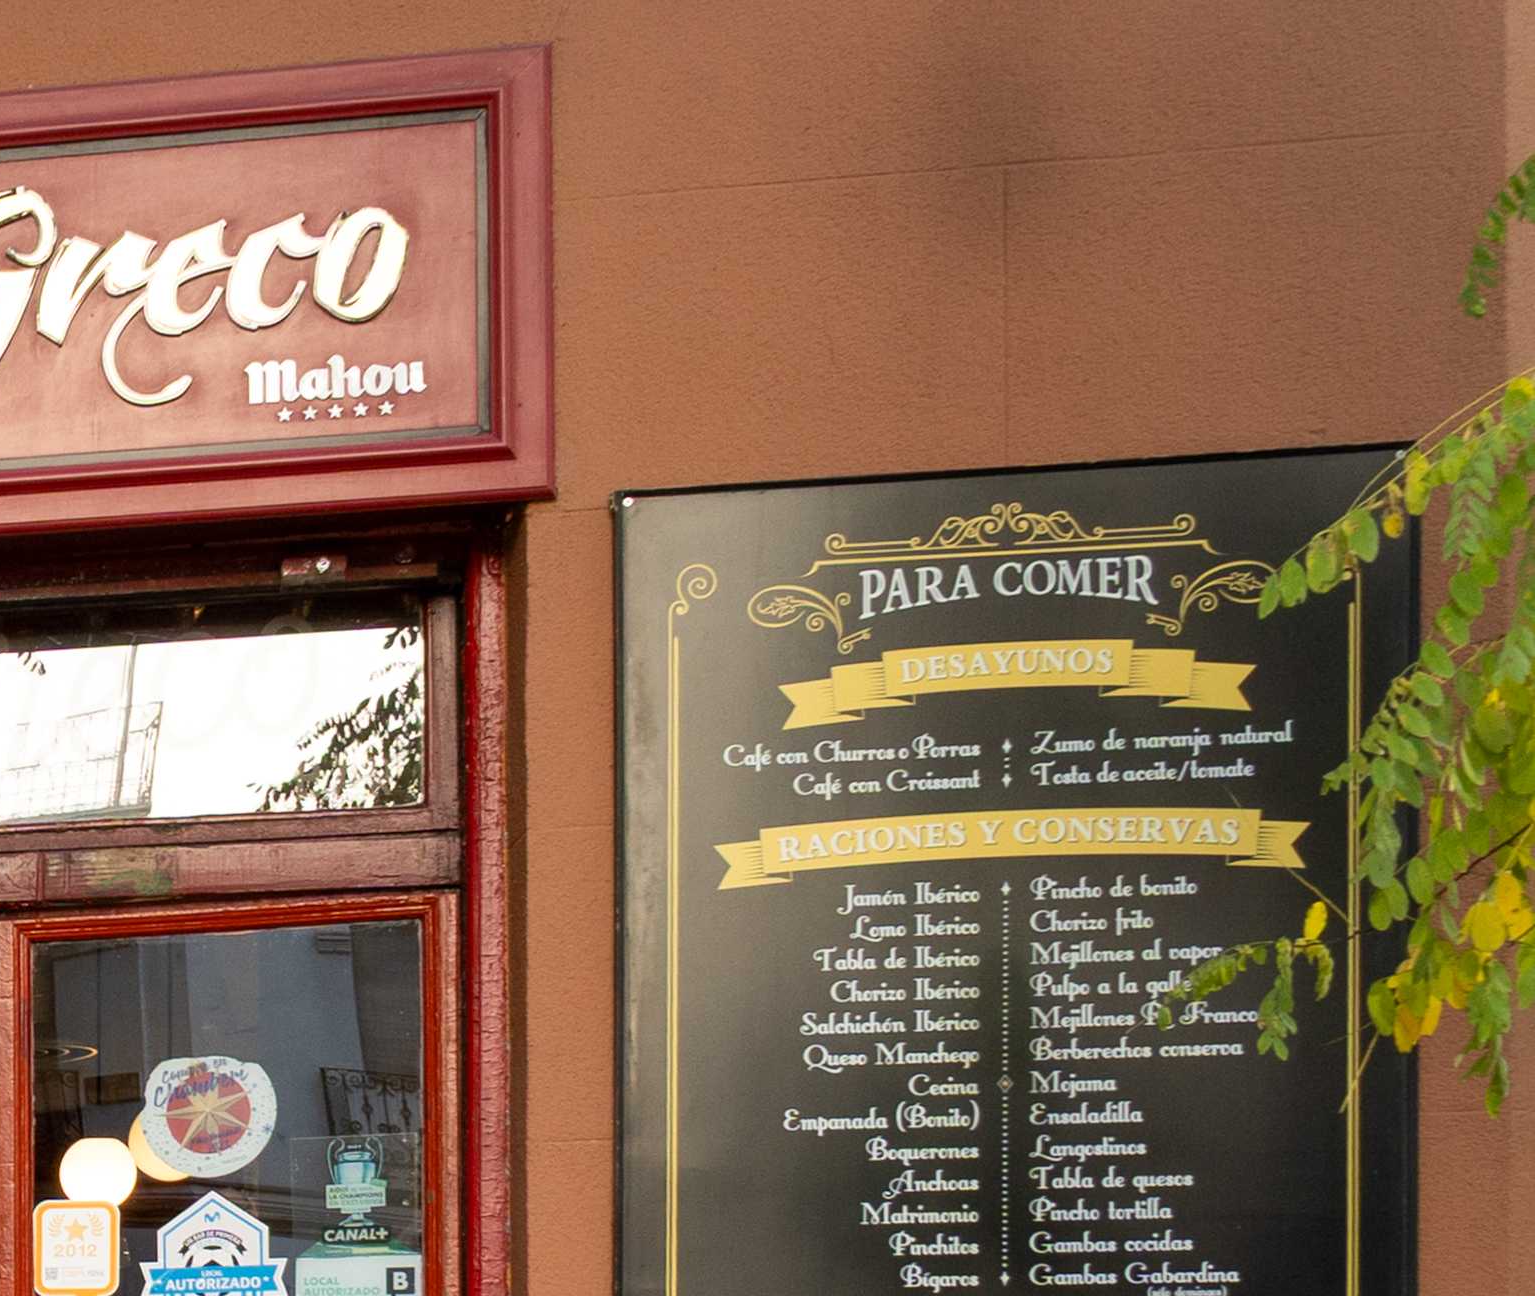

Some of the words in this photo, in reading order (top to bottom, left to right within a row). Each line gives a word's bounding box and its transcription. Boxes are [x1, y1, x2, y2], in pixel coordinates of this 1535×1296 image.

[247, 354, 427, 406] Mahou
[859, 565, 980, 620] PARA
[993, 555, 1158, 605] COMER
[902, 648, 1111, 681] DESAYUNOS
[1031, 731, 1095, 754] Zumo
[1103, 728, 1125, 750] de
[1134, 728, 1211, 756] naranja
[1220, 720, 1292, 744] natural
[722, 743, 772, 772] Café
[776, 748, 810, 766] con
[813, 740, 896, 763] Churros
[897, 746, 911, 760] o
[912, 733, 981, 759] Porras
[779, 823, 965, 863] RACIONES
[979, 820, 1001, 845] Y
[1014, 816, 1237, 842] CONSERVAS
[1030, 875, 1102, 900] Pincho
[1110, 875, 1133, 897] de
[1140, 874, 1197, 896] bonito
[1030, 1036, 1152, 1060] Berberechos
[1159, 1044, 1244, 1057] conserva
[908, 1074, 979, 1096] Cecina
[1031, 1071, 1117, 1098] Mojama
[783, 1107, 888, 1136] Empanada
[896, 1100, 979, 1132] (Bonito)
[1030, 1135, 1146, 1162] Langostinos
[323, 1226, 389, 1243] CANAL+
[53, 1243, 98, 1258] 2012
[165, 1275, 262, 1291] AUTORIZADO
[303, 1277, 340, 1287] LOCAL
[392, 1271, 409, 1291] B
[900, 1263, 979, 1293] Bígaros
[1029, 1263, 1117, 1285] Gambas
[1125, 1262, 1239, 1283] Gabardina
[303, 1286, 381, 1296] AUTORIZADO
